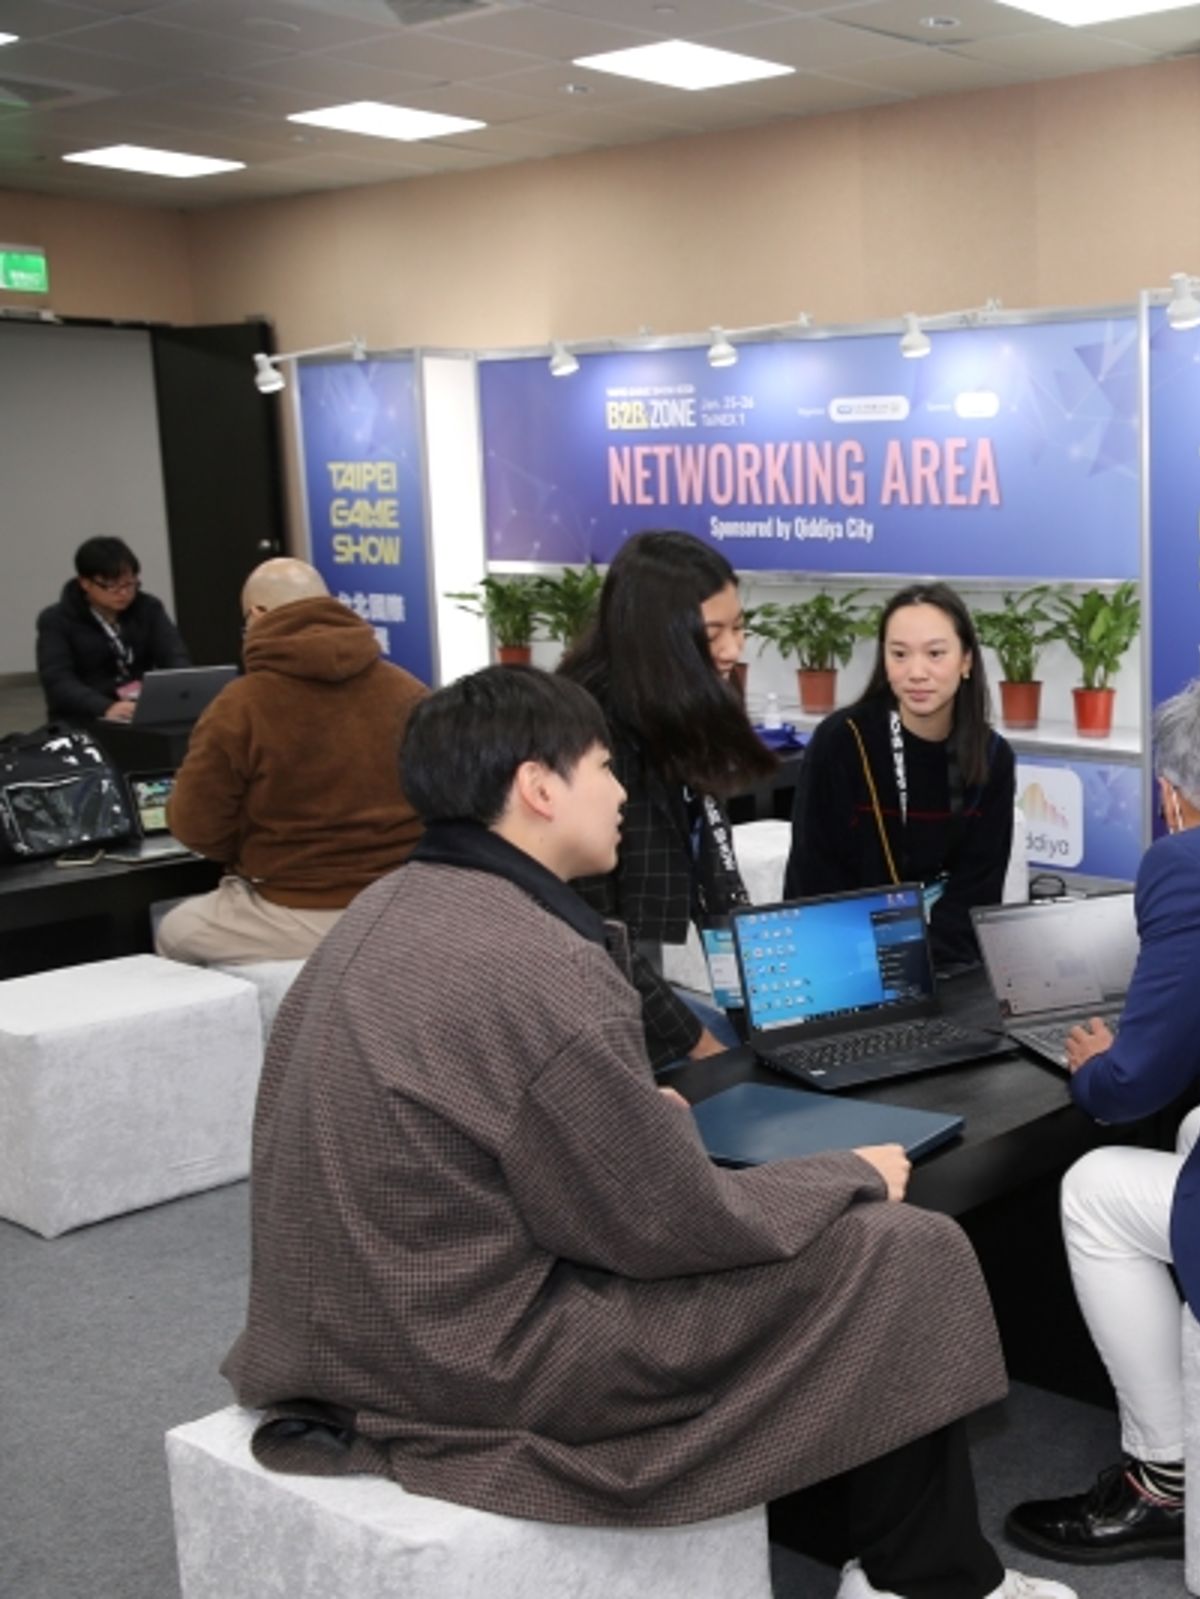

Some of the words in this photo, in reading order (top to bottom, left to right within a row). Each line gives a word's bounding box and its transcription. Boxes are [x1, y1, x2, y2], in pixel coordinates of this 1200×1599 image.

[650, 398, 697, 428] ZONE
[327, 461, 398, 492] TAIPEI
[607, 440, 865, 506] NETWORKING
[881, 437, 1000, 506] AREA
[330, 498, 400, 529] GAME
[710, 515, 773, 541] Sponsored
[776, 516, 791, 541] by
[795, 516, 843, 542] Qiddiya
[846, 517, 874, 543] City
[333, 534, 400, 565] SHOW
[1025, 832, 1069, 858] ddiya
